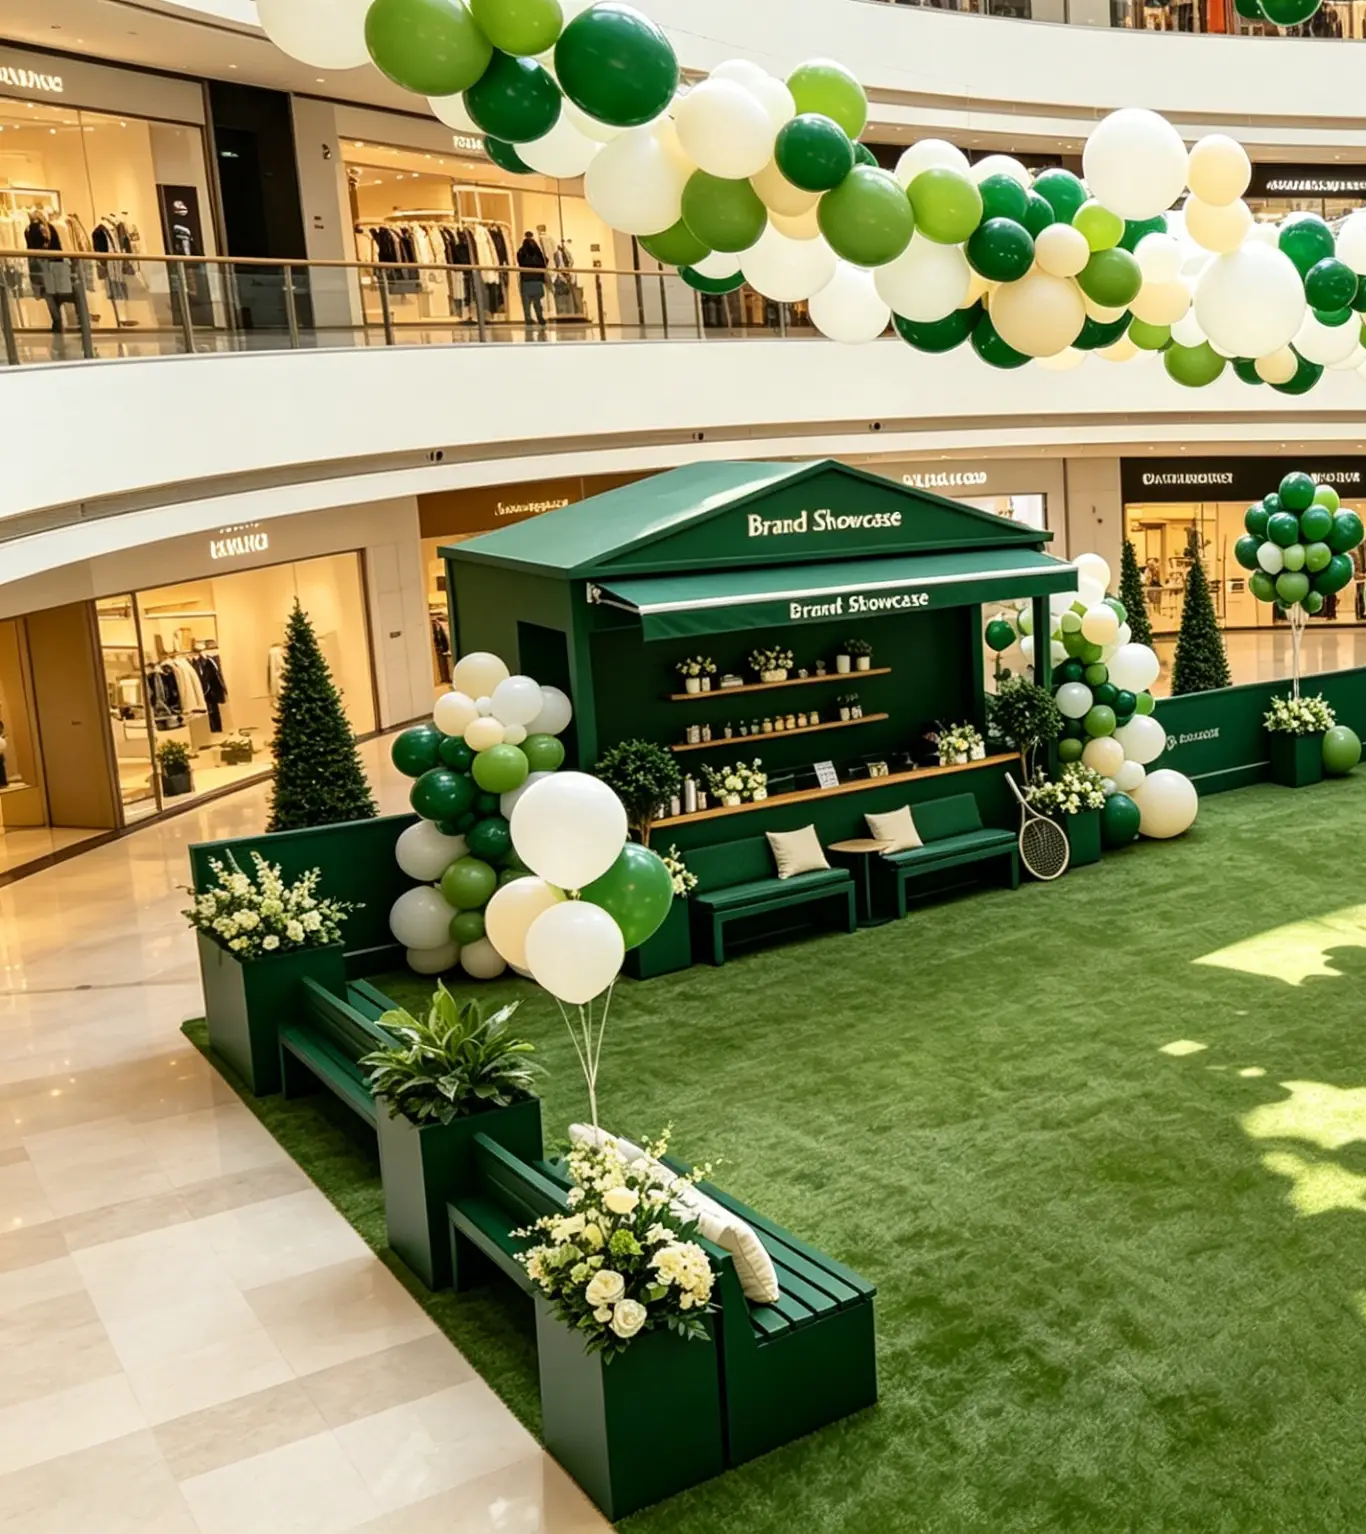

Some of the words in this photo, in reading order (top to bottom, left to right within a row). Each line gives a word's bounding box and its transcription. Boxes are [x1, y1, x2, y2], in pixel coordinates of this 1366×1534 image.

[748, 510, 807, 537] Brand
[813, 508, 902, 532] Showcase
[848, 592, 930, 613] Showcase
